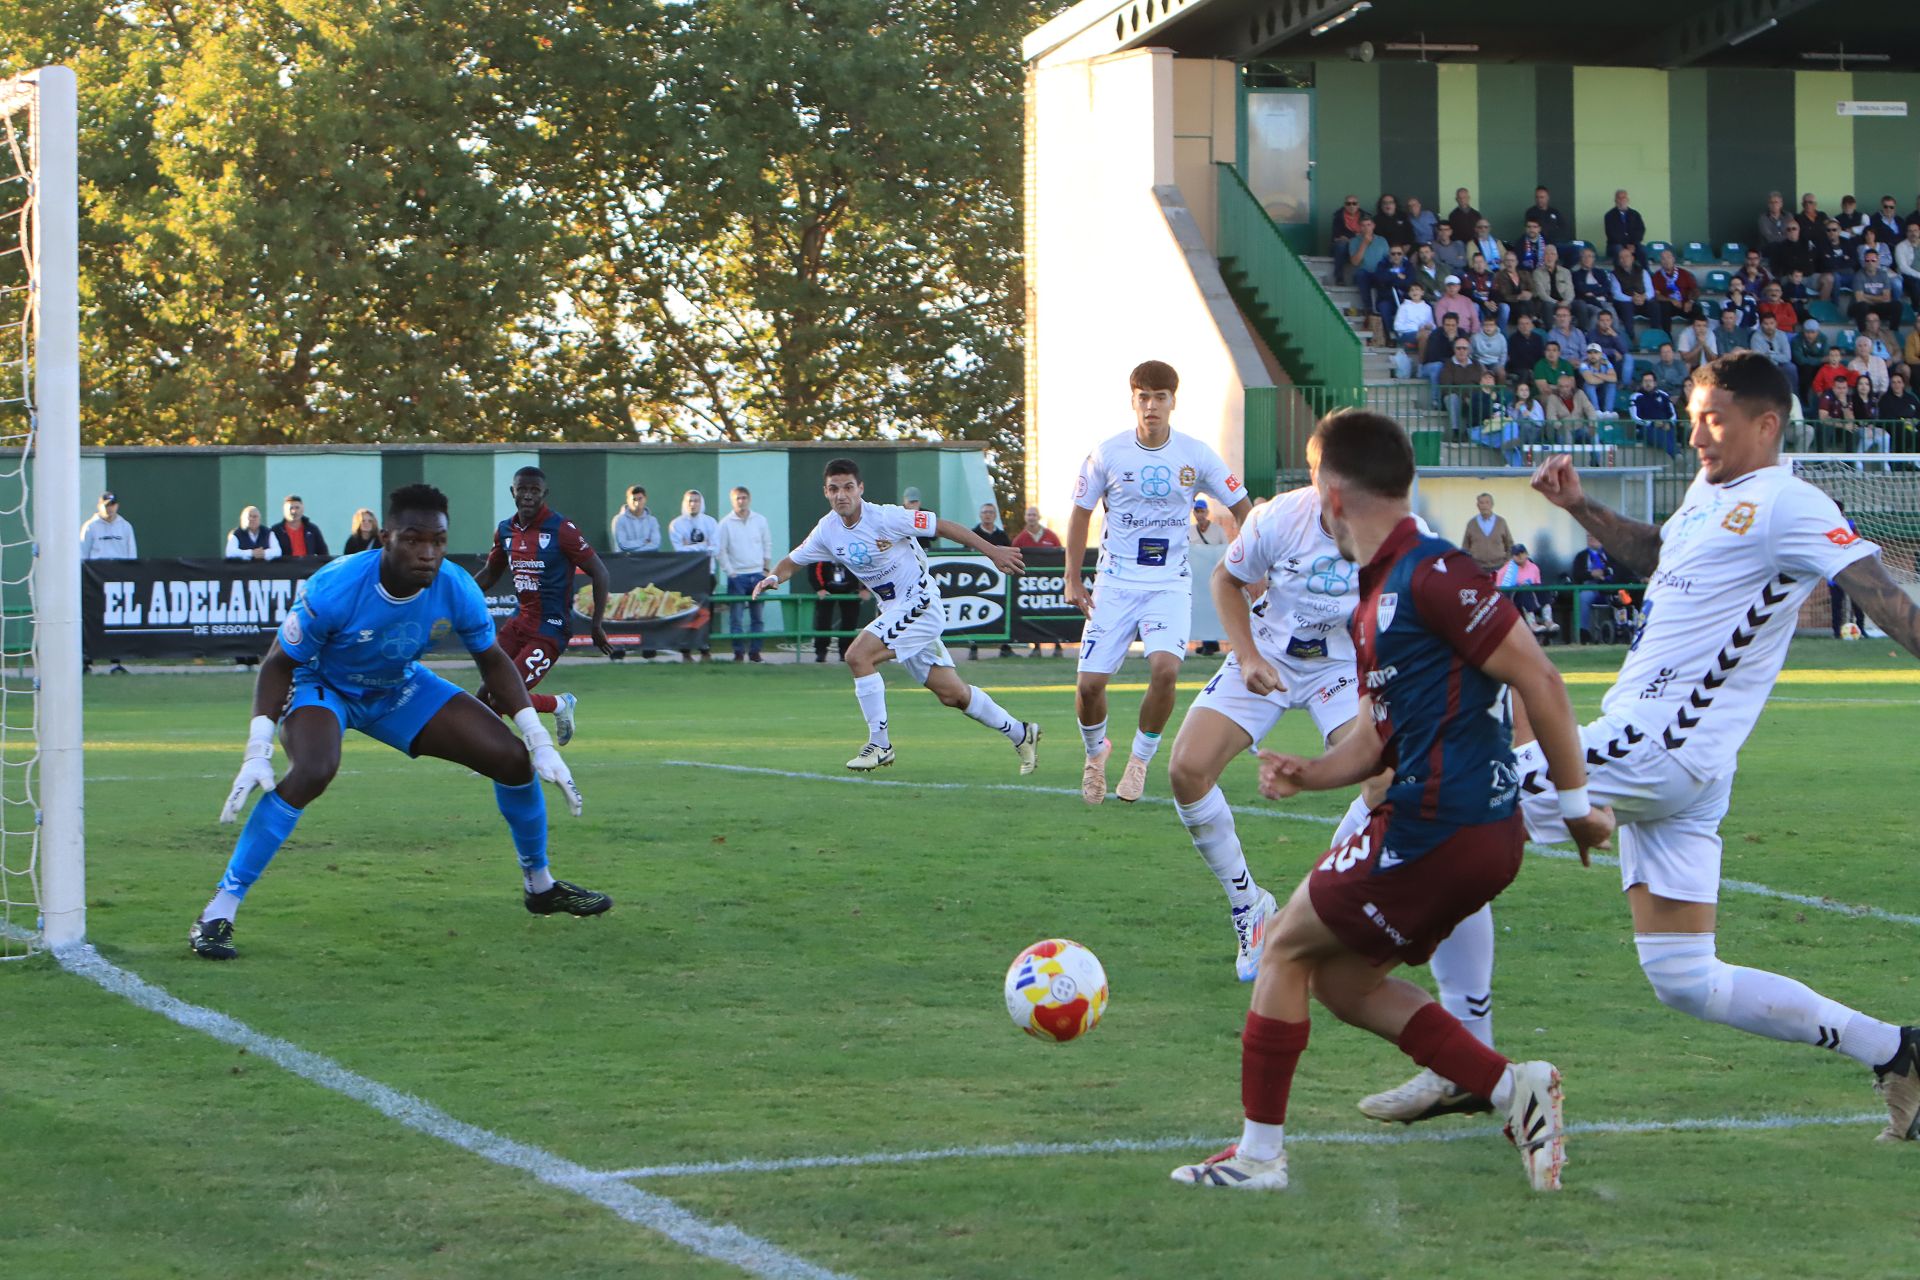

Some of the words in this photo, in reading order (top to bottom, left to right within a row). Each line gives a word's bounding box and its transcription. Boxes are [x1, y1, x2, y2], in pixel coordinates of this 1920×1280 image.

[935, 572, 991, 586] NDA
[1018, 576, 1093, 592] SEGOA
[103, 581, 142, 625] EL
[943, 603, 990, 621] ERO
[193, 626, 209, 635] DE
[212, 625, 260, 635] SEGOVIA
[525, 648, 551, 677] 22
[1204, 673, 1223, 695] 4
[314, 686, 324, 701] 1
